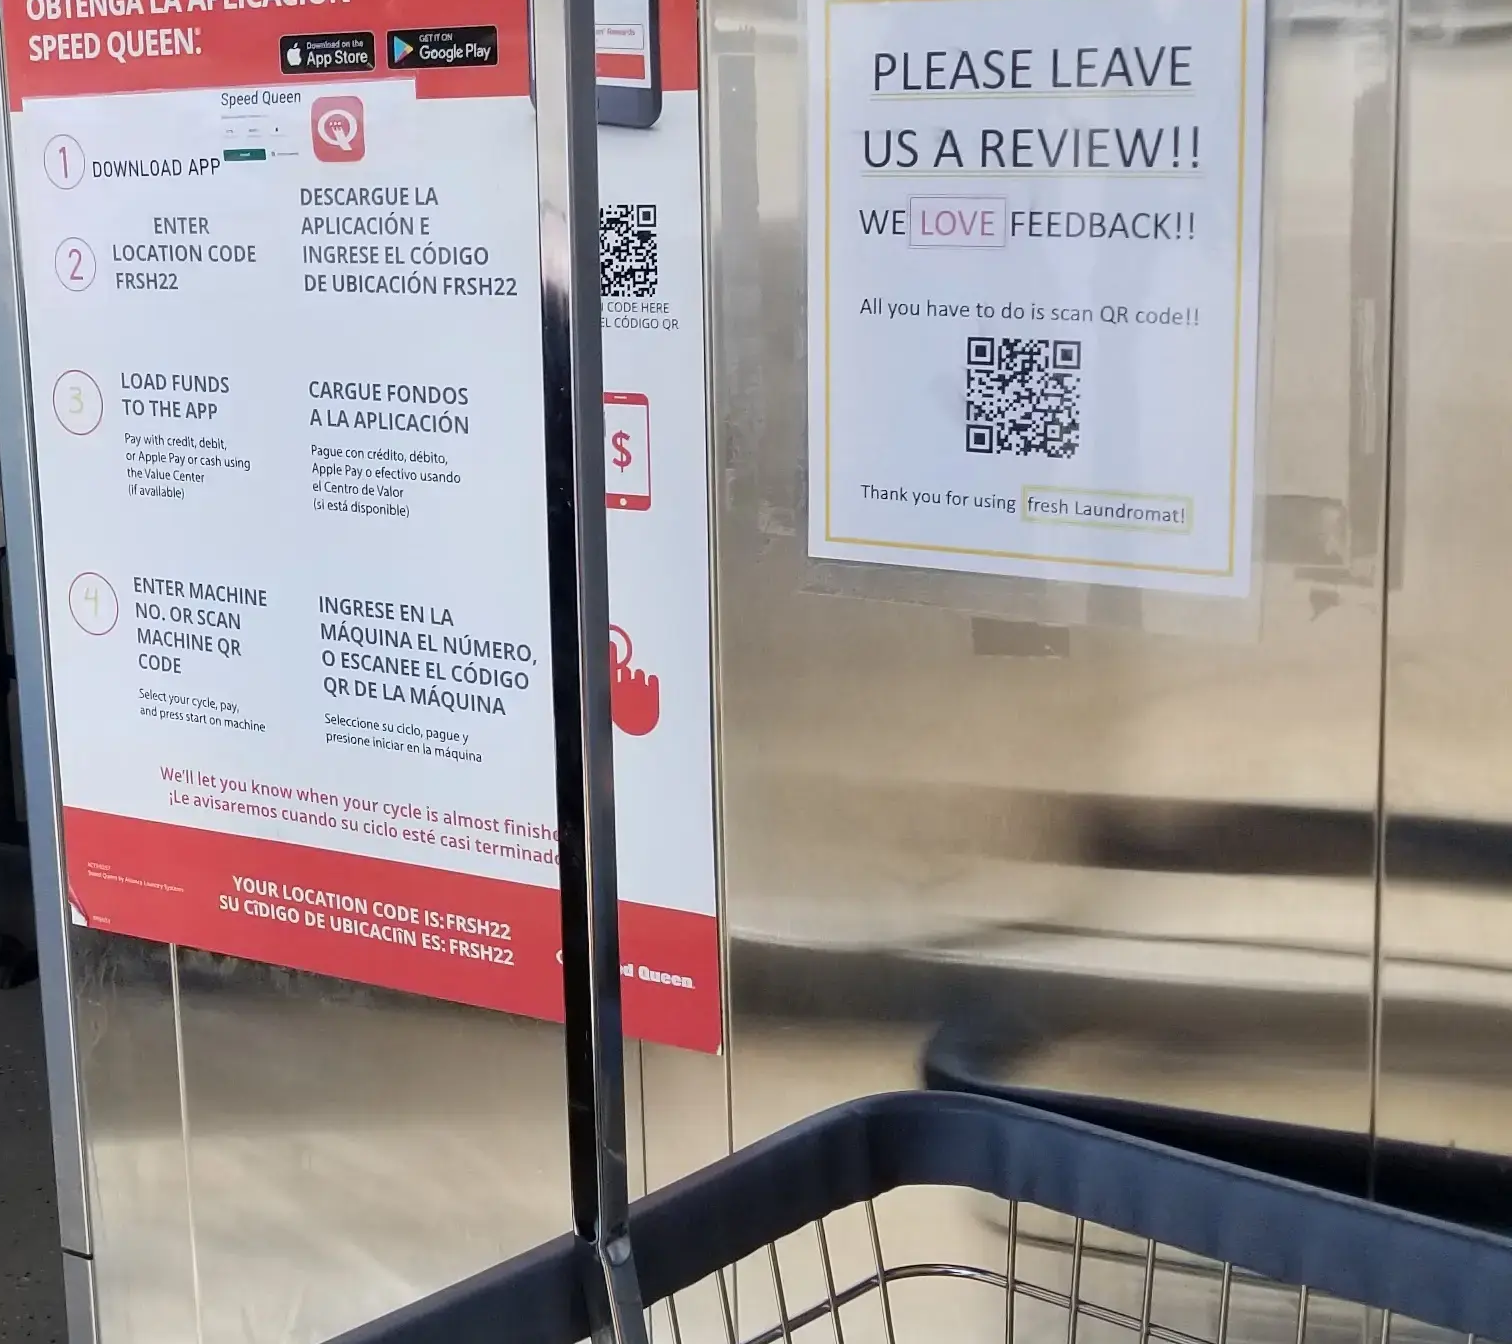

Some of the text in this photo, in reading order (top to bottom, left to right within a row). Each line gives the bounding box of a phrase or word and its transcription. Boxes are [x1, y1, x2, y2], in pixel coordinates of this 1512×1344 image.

[29, 33, 100, 62] SPEED
[306, 41, 340, 50] Download
[352, 39, 363, 47] the
[419, 43, 491, 62] Google Play
[307, 50, 368, 68] App Store
[873, 46, 1193, 92] PLEASE LEAVE
[221, 91, 301, 109] Speed Queen
[863, 126, 1200, 168] US A REVIEW!!
[58, 146, 220, 178] 1 DOWNLOAD APP
[300, 187, 438, 206] DESCARGUE LA
[154, 217, 209, 234] ENTER
[301, 212, 429, 235] APLICACIÓN E
[859, 210, 1197, 239] WE LOVE FEEDBACK!!
[69, 248, 83, 280] 2
[113, 244, 256, 262] LOCATION CODE
[303, 242, 488, 265] INGRESE EL CÓDIGO
[116, 273, 178, 290] FRSH22
[304, 271, 517, 295] DE UBICACIÓN FRSH22
[607, 302, 669, 313] CODE HERE
[860, 298, 1199, 326] All you have to do is scan QR code!!
[614, 316, 658, 328] CÓDIGO
[663, 319, 678, 331] QR
[121, 373, 229, 393] LOAD FUNDS
[309, 381, 468, 405] CARGUE FONDOS
[122, 399, 217, 419] TO THE APP
[310, 409, 469, 434] A LA APLICACIÓN
[125, 433, 227, 451] Pay with credit, debit,
[861, 485, 1185, 524] Thank you for using fresh Laundromat!
[160, 766, 499, 833] We'll let you know when your cycle is almost
[232, 875, 512, 940] YOUR LOCATION CODE IS: FRSH22
